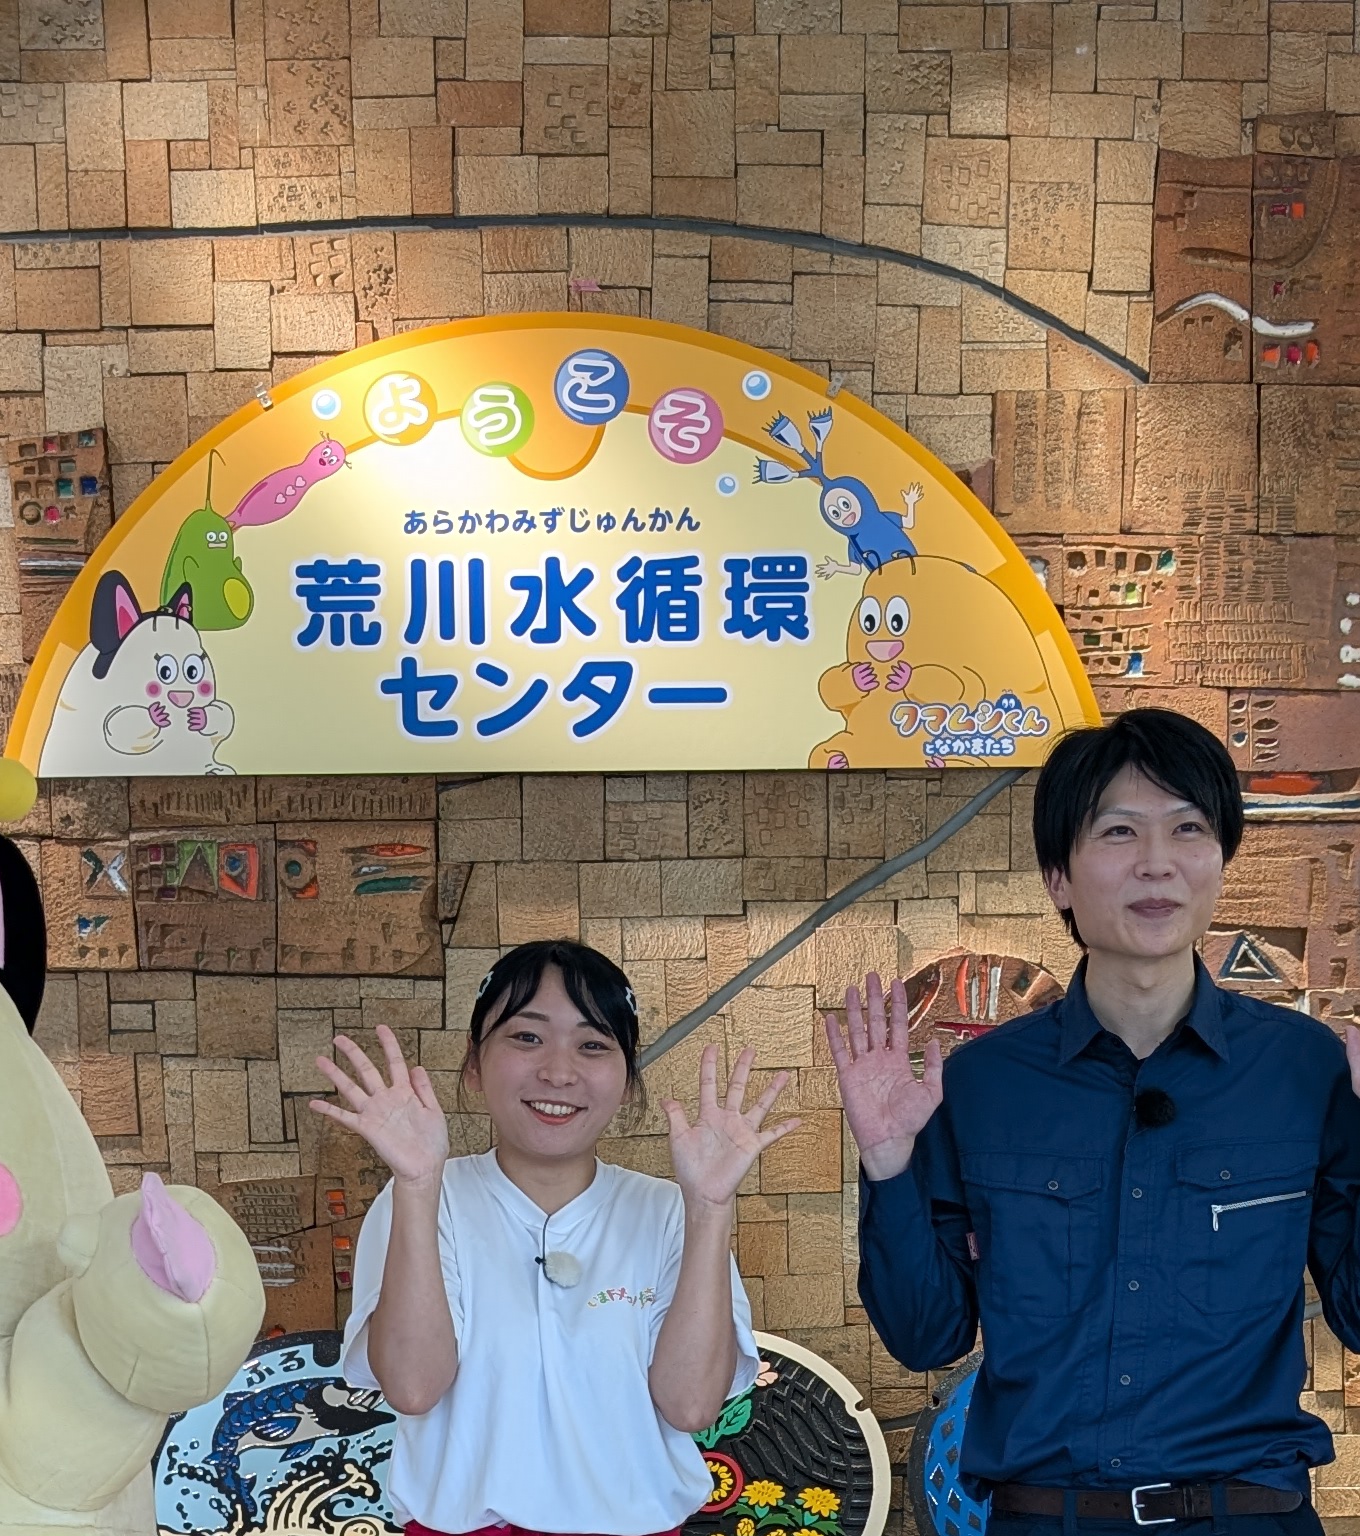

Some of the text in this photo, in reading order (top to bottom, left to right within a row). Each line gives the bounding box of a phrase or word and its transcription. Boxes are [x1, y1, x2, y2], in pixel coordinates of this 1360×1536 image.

[373, 357, 711, 454] ようこそ
[403, 506, 702, 535] あらかわみずじゅんかん
[295, 555, 810, 647] 荒川水循環
[380, 656, 728, 737] センター
[892, 701, 1048, 736] クマムシくん
[925, 737, 1015, 756] となかまたち
